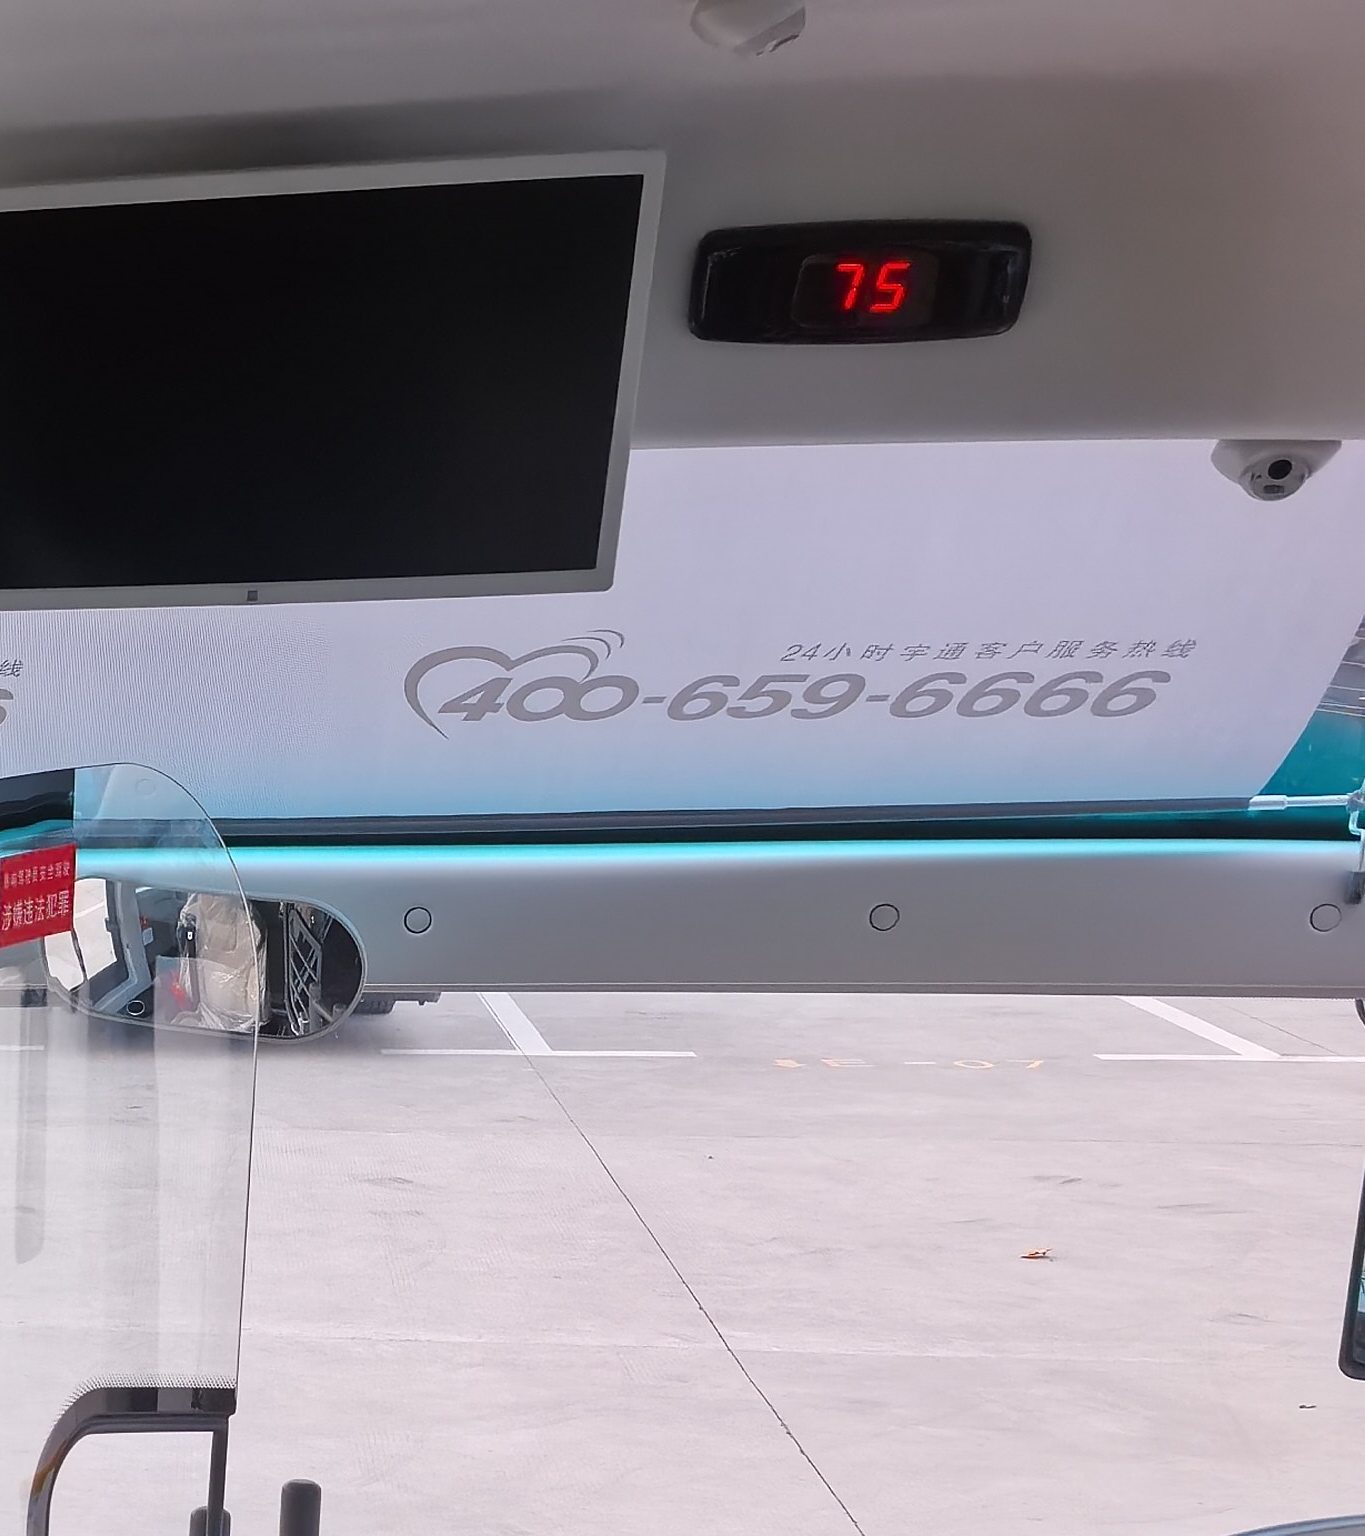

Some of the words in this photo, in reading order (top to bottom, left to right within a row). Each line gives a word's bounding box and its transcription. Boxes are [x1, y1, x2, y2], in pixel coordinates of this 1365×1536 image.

[837, 261, 912, 313] 75
[780, 639, 1197, 663] 24小时宇通客户服务热线
[437, 670, 1172, 723] 400-659-6666
[1, 889, 70, 931] 涉嫌违法犯罪
